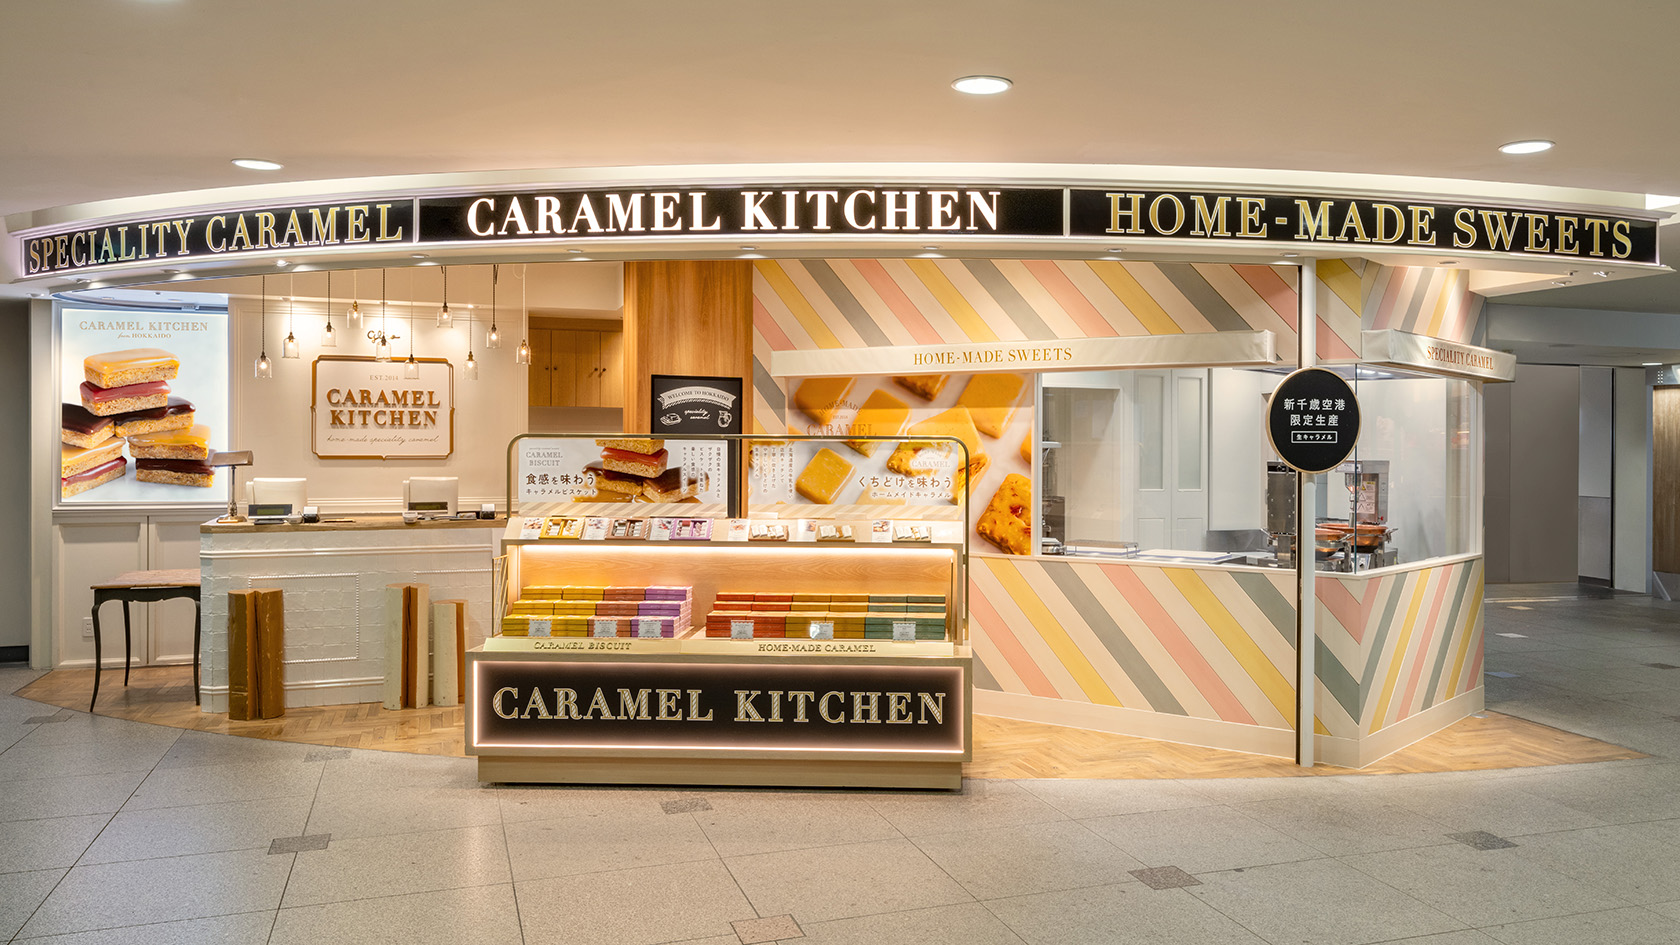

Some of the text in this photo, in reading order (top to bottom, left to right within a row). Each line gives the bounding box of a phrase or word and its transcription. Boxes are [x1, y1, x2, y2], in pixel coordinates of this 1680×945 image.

[466, 189, 1002, 237] CARAMEL KITCHEN
[1105, 192, 1633, 259] HOME-MADE SWEETS
[29, 203, 403, 274] SPECIALITY CARAMEL
[79, 320, 208, 332] CARAMEL KITCHEN
[913, 347, 1073, 366] HOME-MADE SWEETS
[1426, 345, 1494, 370] SPECIALITY CARAMEL
[326, 388, 441, 407] CARAMEL
[667, 390, 693, 400] WELCOME
[702, 391, 730, 401] HOKKAIDO
[1283, 398, 1346, 411] 新千歳空港
[329, 409, 438, 427] KITCHEN
[1290, 414, 1339, 427] 限定生産
[806, 423, 878, 437] CARAMEL
[1296, 433, 1333, 441] 生キャラメル
[525, 451, 564, 459] CARAMEL
[529, 459, 561, 467] BISCUIT
[911, 460, 951, 469] CARAMEL
[525, 472, 594, 486] 食感を味わう
[858, 475, 951, 489] くちどけを味わう
[525, 488, 597, 496] キャラメルビスケット
[533, 641, 633, 651] CARAMEL BISCUIT
[824, 644, 877, 653] CARAMEL
[492, 686, 946, 725] CARAMEL KITCHEN
